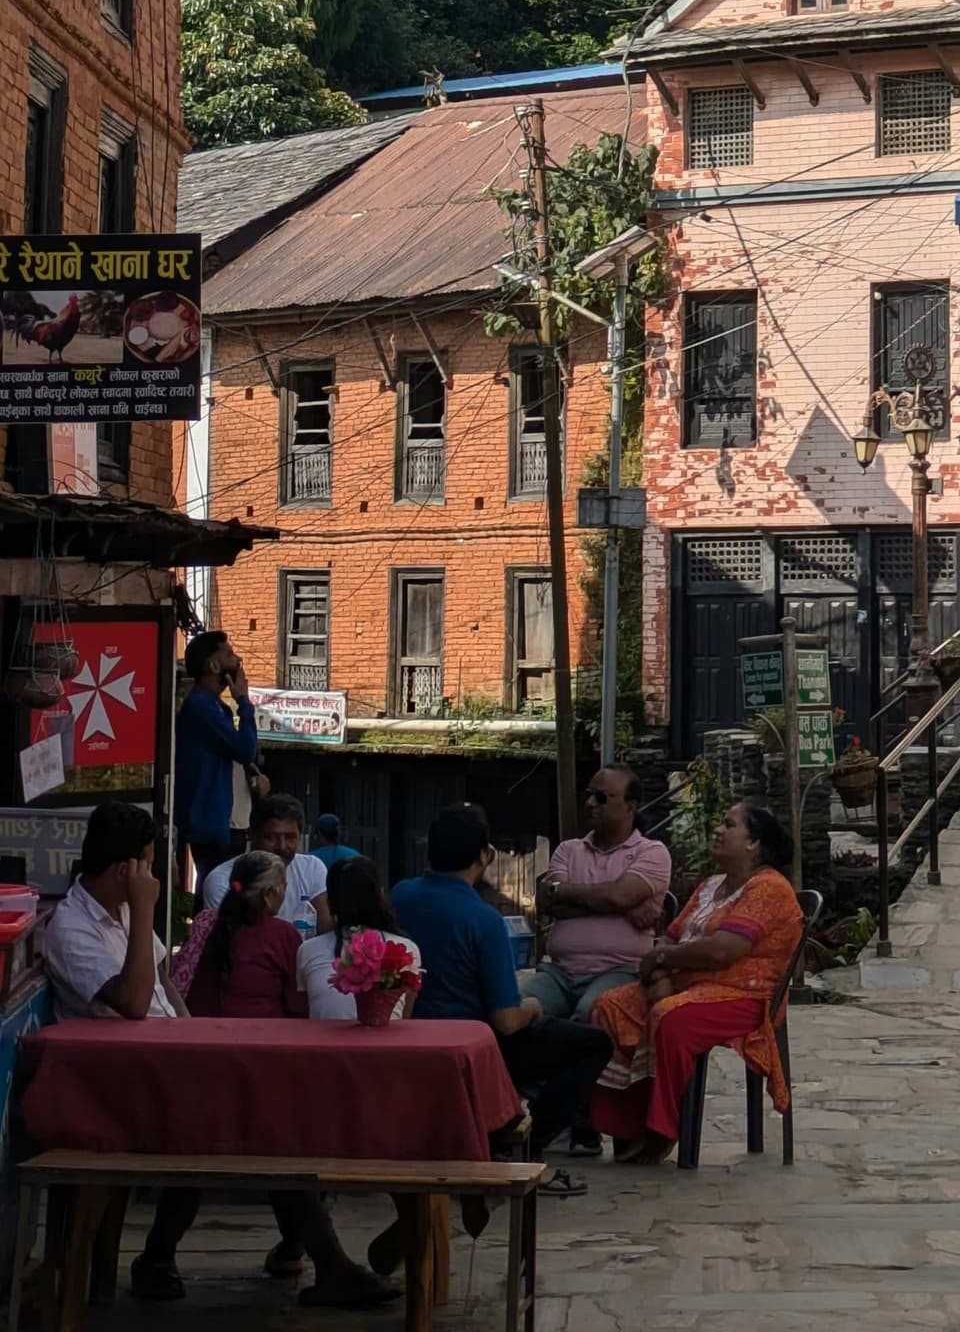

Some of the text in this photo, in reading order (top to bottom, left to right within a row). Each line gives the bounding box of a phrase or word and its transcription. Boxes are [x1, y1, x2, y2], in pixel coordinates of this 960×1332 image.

[18, 241, 83, 283] रैथाने
[91, 250, 150, 282] खाना
[157, 250, 193, 281] घर
[109, 368, 139, 382] लोकल
[69, 385, 99, 399] लोकल
[798, 733, 833, 750] Bus Park
